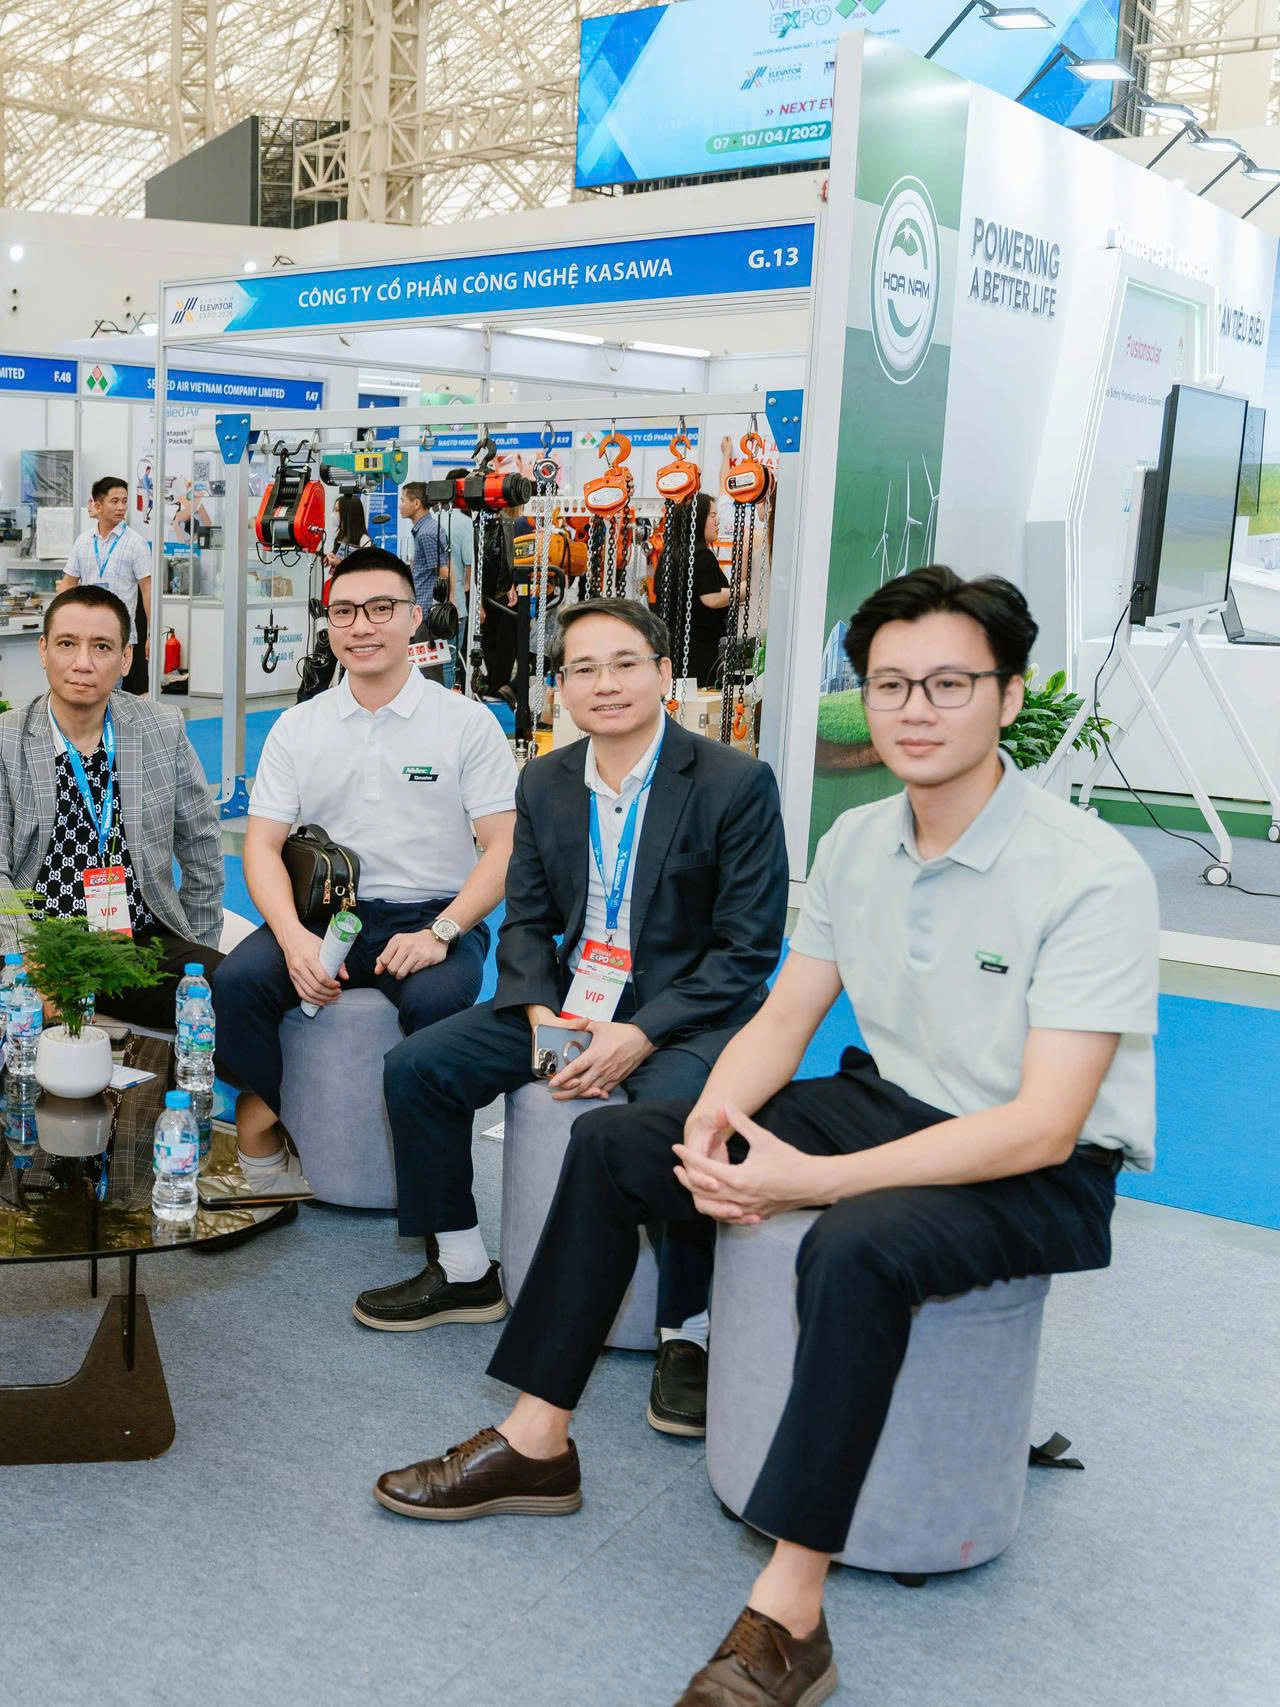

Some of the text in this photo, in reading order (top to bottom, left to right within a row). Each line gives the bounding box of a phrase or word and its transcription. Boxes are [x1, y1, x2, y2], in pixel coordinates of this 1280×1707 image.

[769, 5, 831, 38] EXPO
[779, 99, 816, 116] NEXT
[713, 123, 827, 150] 07 10/04/2027
[748, 246, 799, 269] G.13
[971, 216, 1060, 280] POWERING
[298, 257, 673, 308] CÔNG TY CỔ PHẦN CÔNG NGHỆ KASAWA
[883, 271, 930, 299] HOA NAM
[969, 267, 1057, 318] A BETTER LIFE
[199, 301, 233, 312] ELEVATOR
[54, 370, 71, 383] F.48
[147, 378, 285, 400] SEED AIR VIETNAM COMPANY LIMITED
[100, 907, 117, 917] VIP
[585, 989, 605, 1003] VIP
